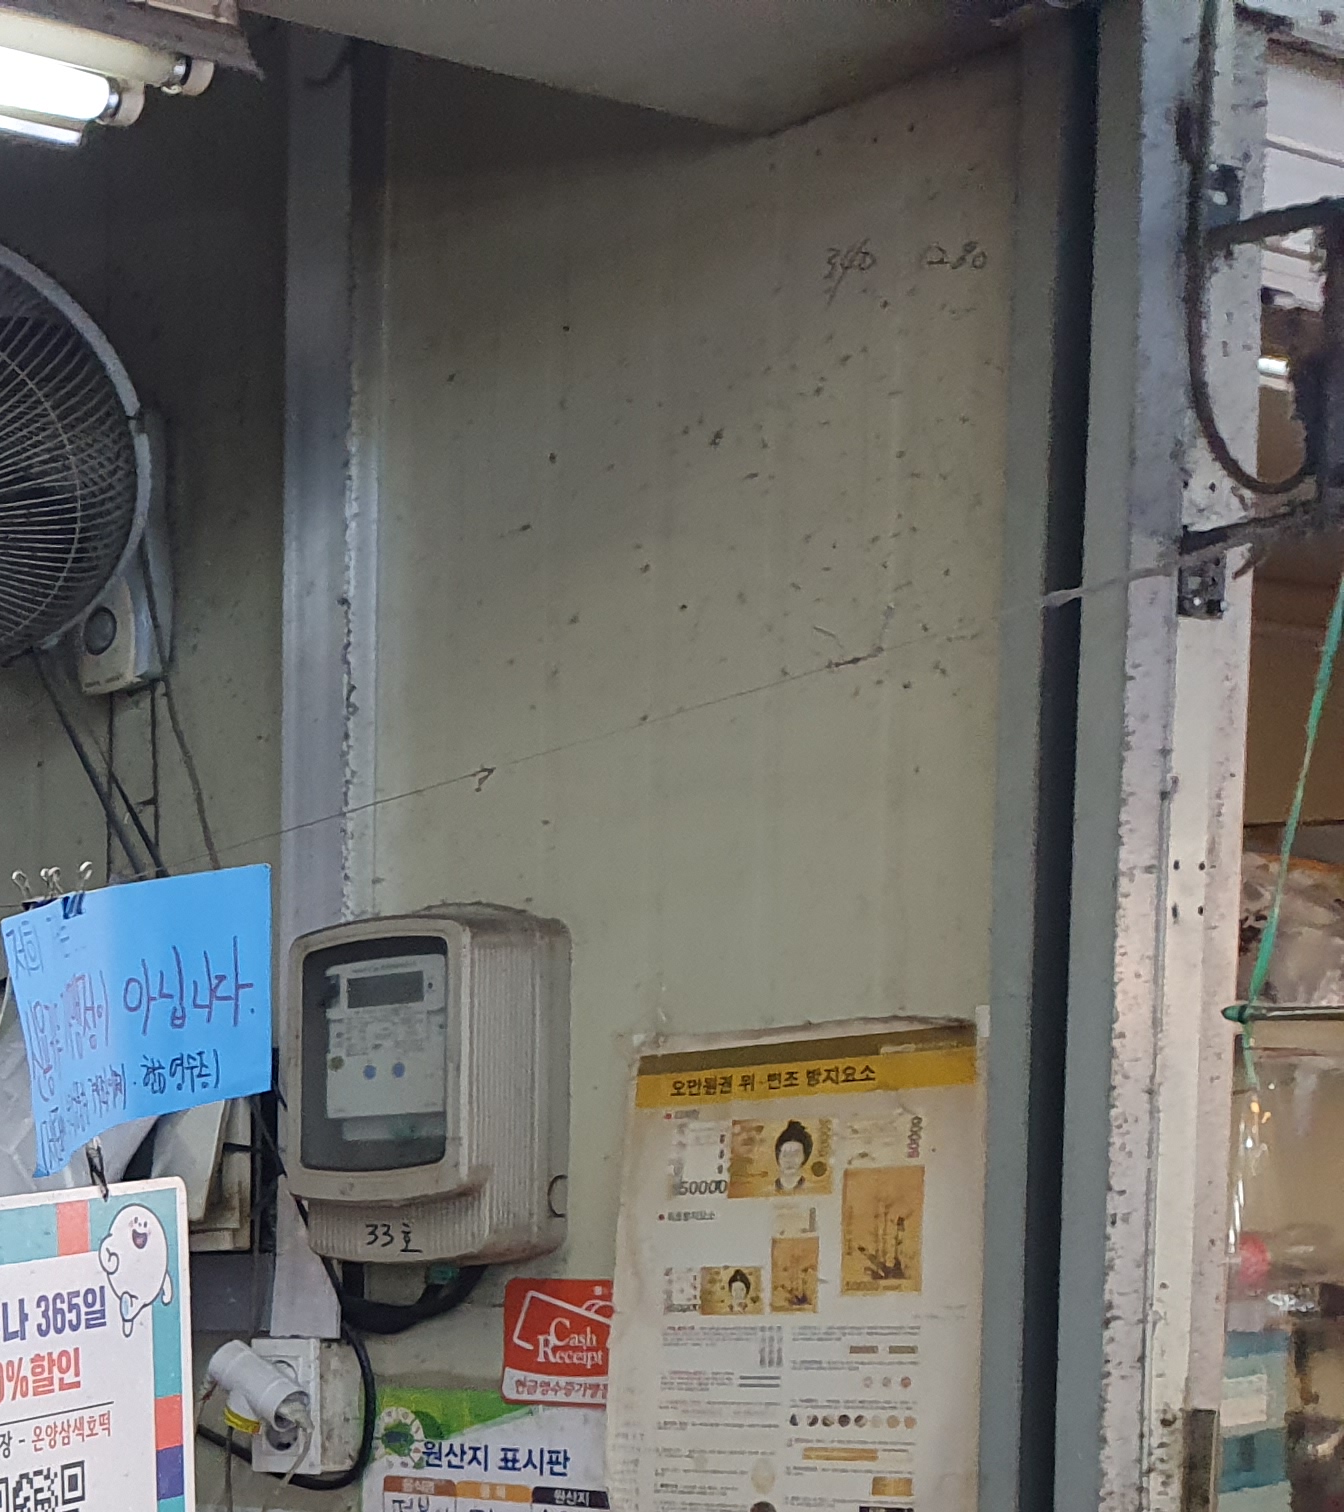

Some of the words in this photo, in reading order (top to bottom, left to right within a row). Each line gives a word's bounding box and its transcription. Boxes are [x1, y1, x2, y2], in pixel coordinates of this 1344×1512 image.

[670, 1074, 733, 1097] 오만원권
[806, 1065, 876, 1086] 방지요소
[36, 1285, 107, 1338] 365일
[550, 1317, 597, 1347] Cash
[537, 1334, 603, 1369] Receipt
[32, 1410, 111, 1452] 온양삼색호떡
[422, 1440, 489, 1472] 원산지
[498, 1447, 570, 1477] 표시판
